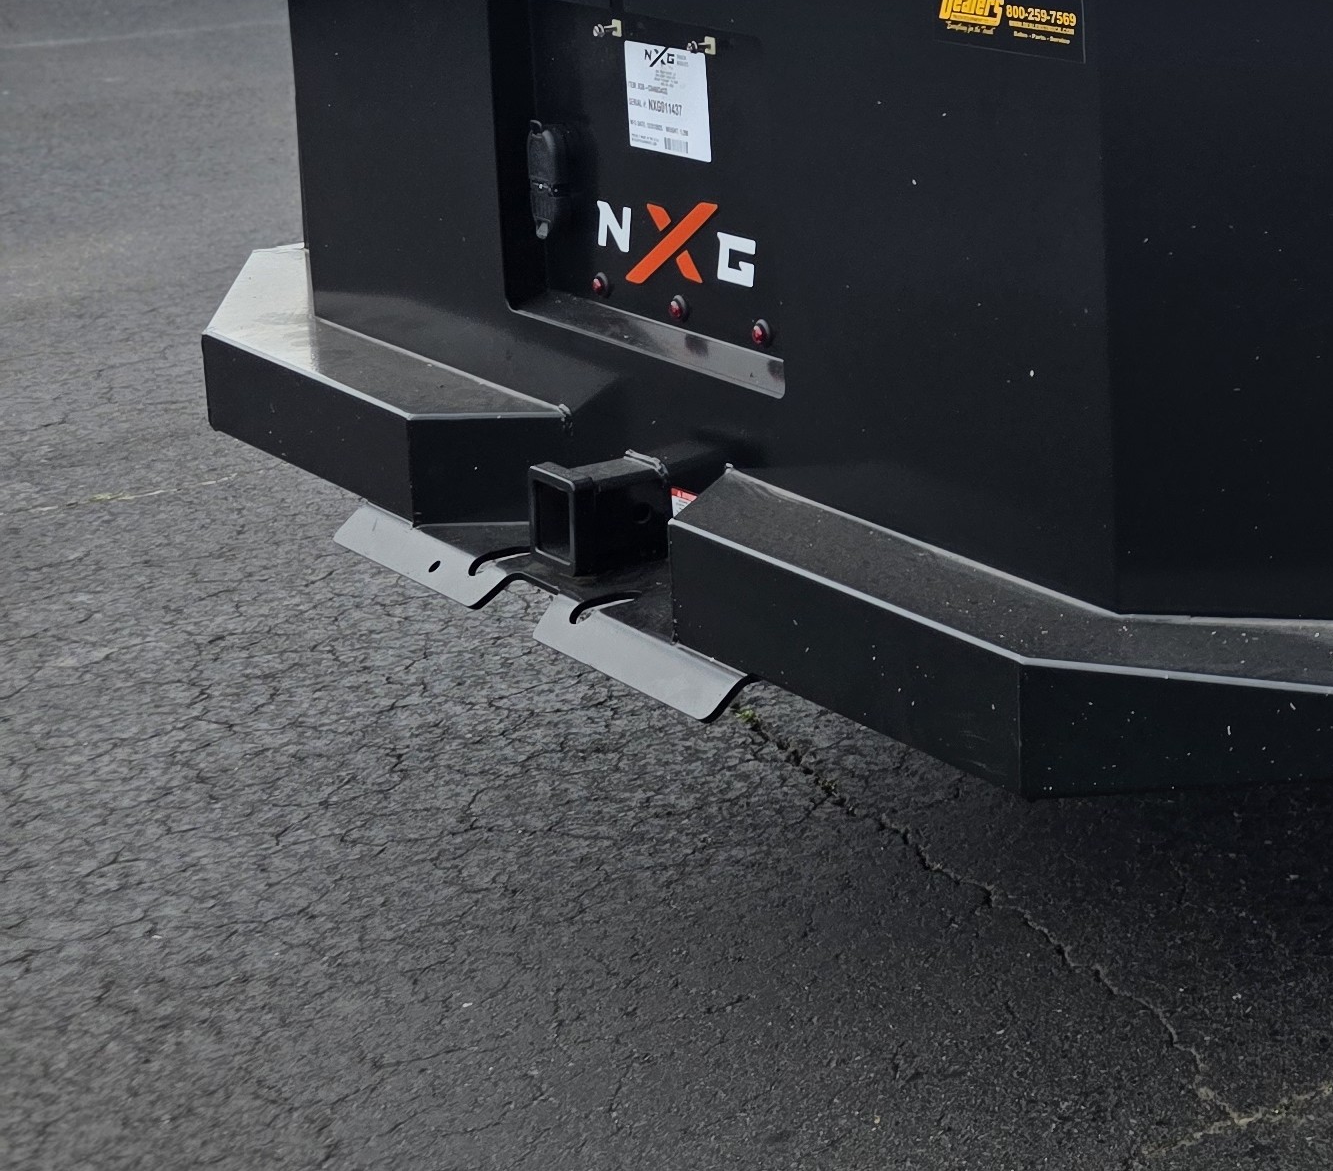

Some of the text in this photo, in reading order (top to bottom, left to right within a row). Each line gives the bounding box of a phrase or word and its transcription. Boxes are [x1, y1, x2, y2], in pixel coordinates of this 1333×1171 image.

[1006, 4, 1077, 27] 800-259-7569
[644, 47, 675, 67] NXG
[596, 200, 756, 288] NXG
